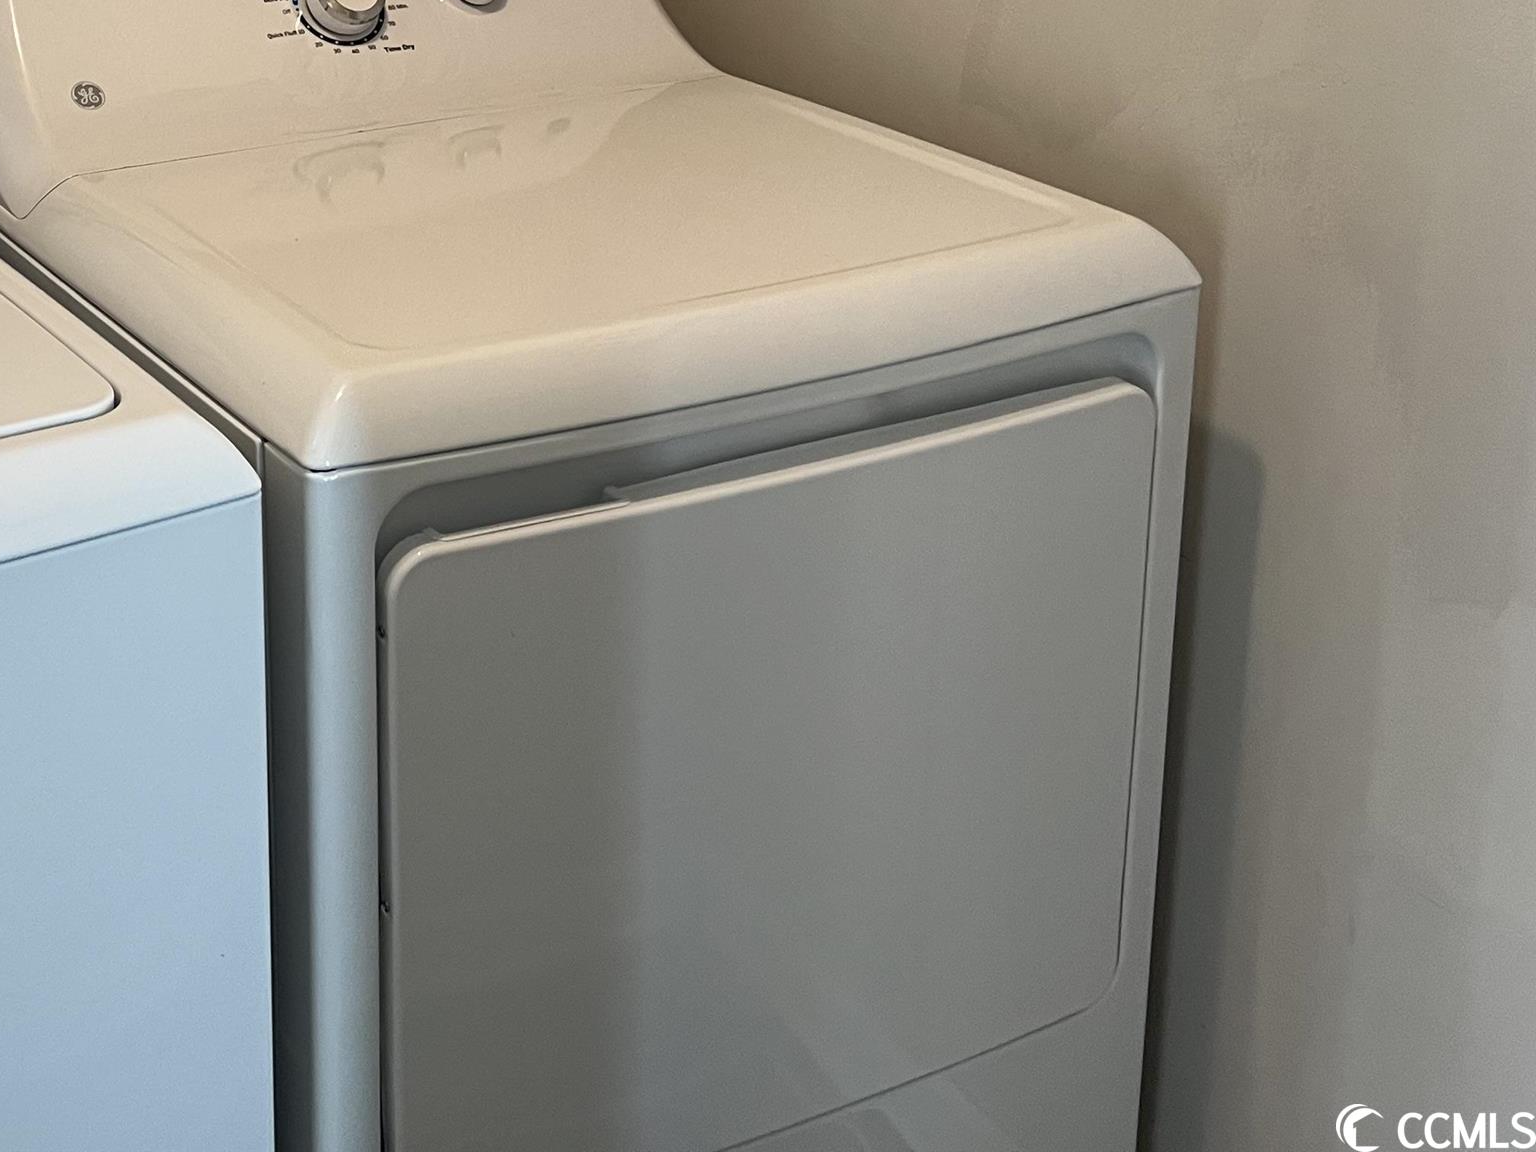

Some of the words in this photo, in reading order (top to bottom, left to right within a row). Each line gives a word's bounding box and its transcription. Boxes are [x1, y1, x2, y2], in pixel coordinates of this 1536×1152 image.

[267, 32, 283, 40] Quick
[384, 45, 401, 53] Time
[402, 44, 415, 52] Dry
